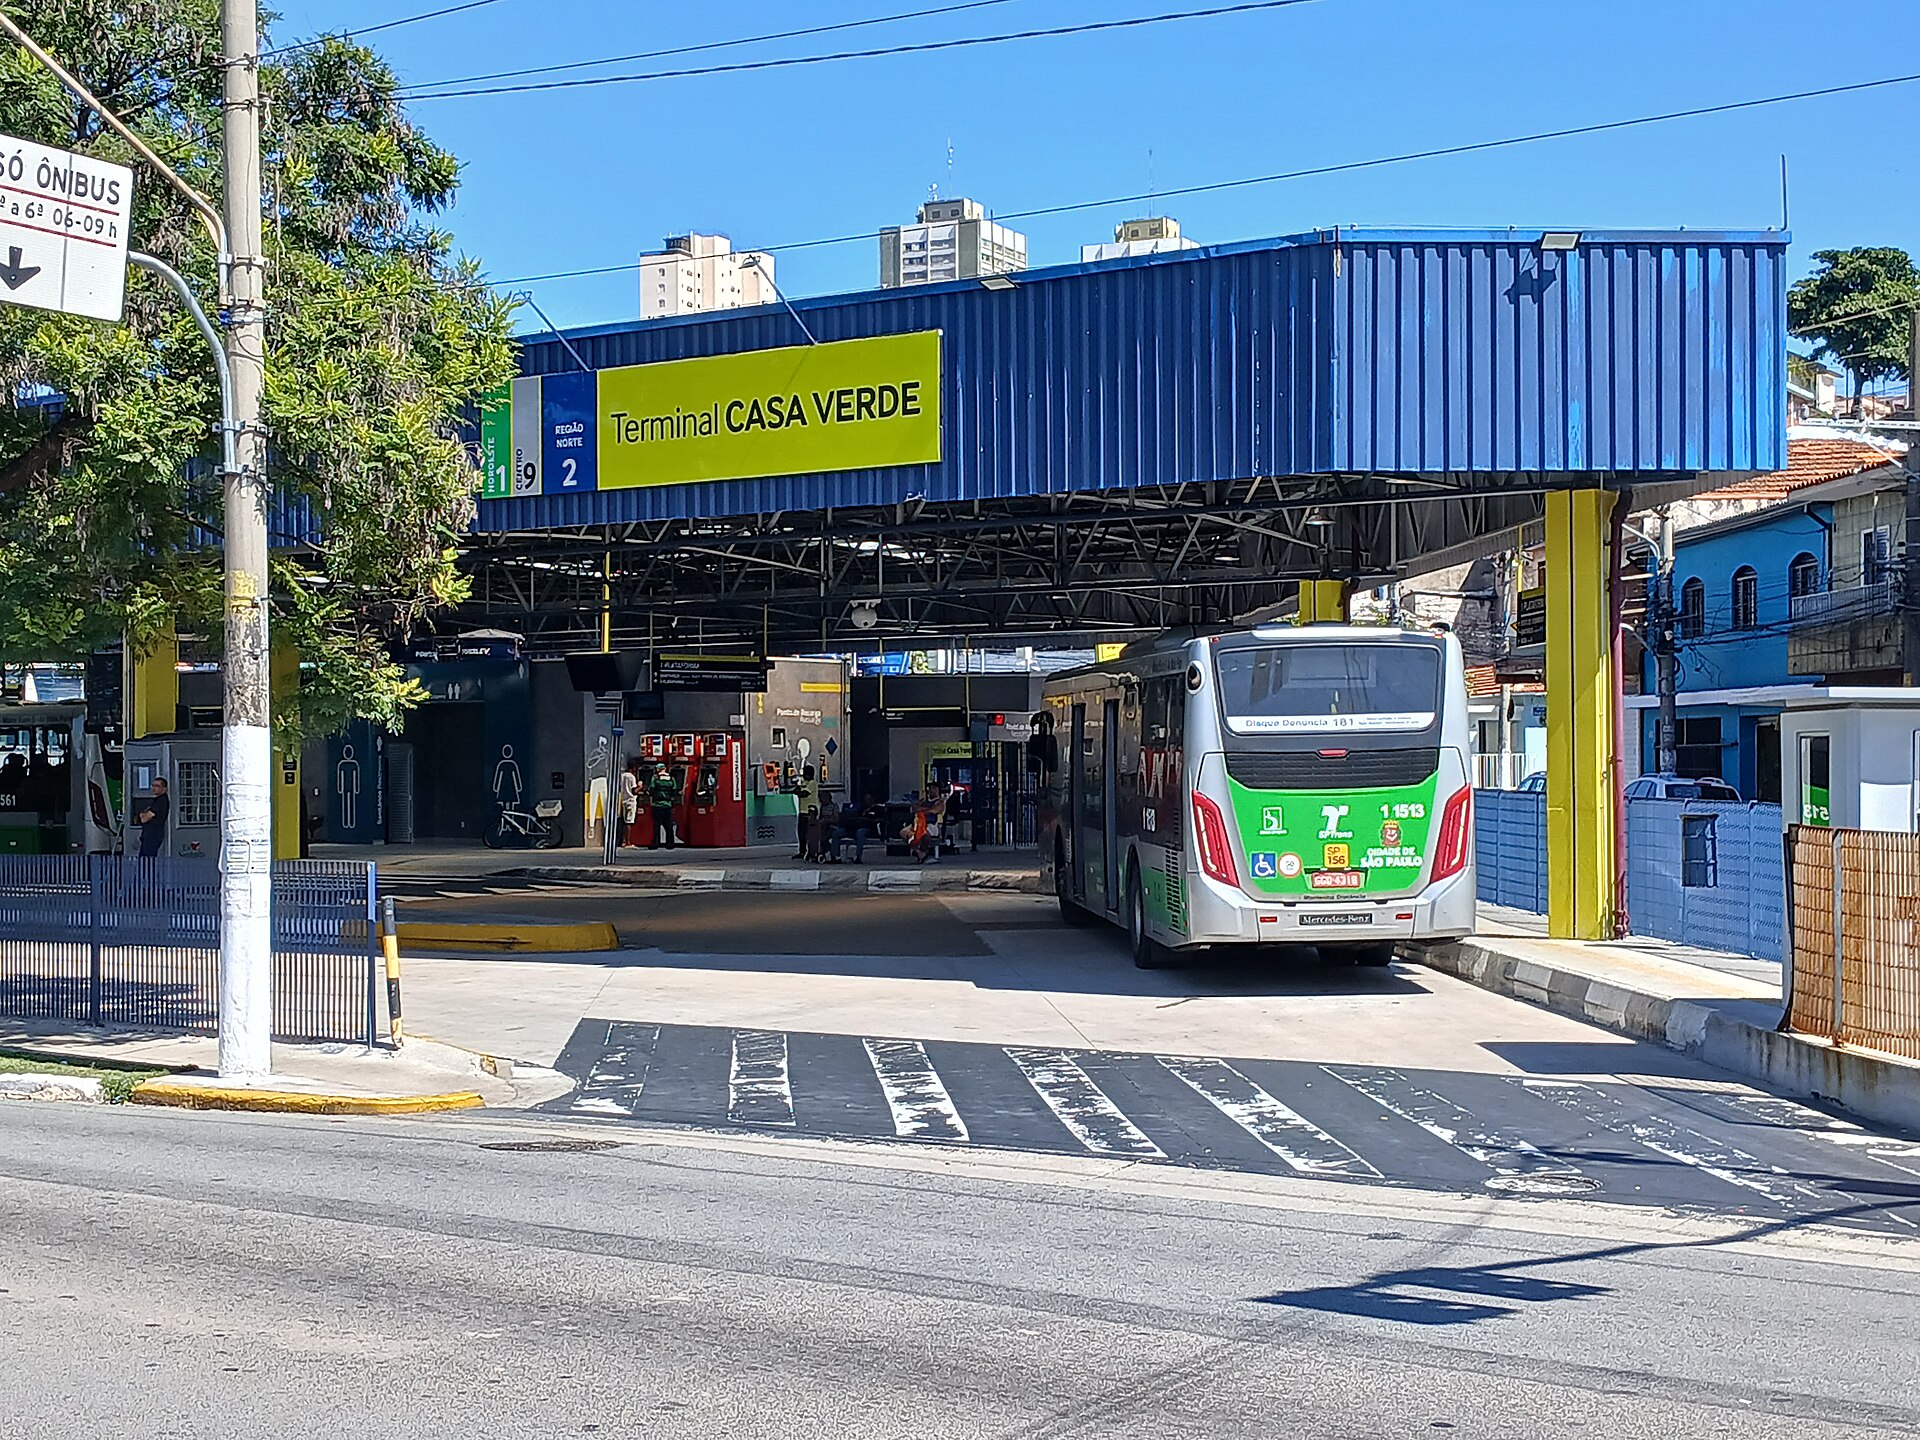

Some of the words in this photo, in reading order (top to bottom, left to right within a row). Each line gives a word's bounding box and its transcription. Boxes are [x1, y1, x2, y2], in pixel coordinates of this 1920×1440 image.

[37, 157, 120, 205] ÔNIBUS
[53, 208, 104, 234] 06-09
[109, 222, 117, 238] h
[611, 402, 718, 444] Terminal
[725, 394, 807, 432] CASA
[812, 381, 920, 424] VERDE
[555, 421, 584, 435] REGIÃO
[556, 437, 583, 448] NORTE
[496, 465, 506, 492] 1
[523, 462, 536, 489] 9
[562, 458, 577, 486] 2
[1282, 718, 1328, 727] Denúncia
[1332, 717, 1354, 727] 181
[1381, 804, 1389, 818] 1
[1392, 803, 1425, 818] 1513
[1318, 830, 1353, 839] SPTrans
[1327, 846, 1340, 855] SP
[1366, 847, 1400, 857] CIDADE
[1402, 847, 1416, 856] DE
[1327, 855, 1346, 865] 156
[1360, 855, 1383, 868] SÃO
[1385, 857, 1423, 867] PAULO
[1302, 914, 1371, 925] Mercedes-Benz
